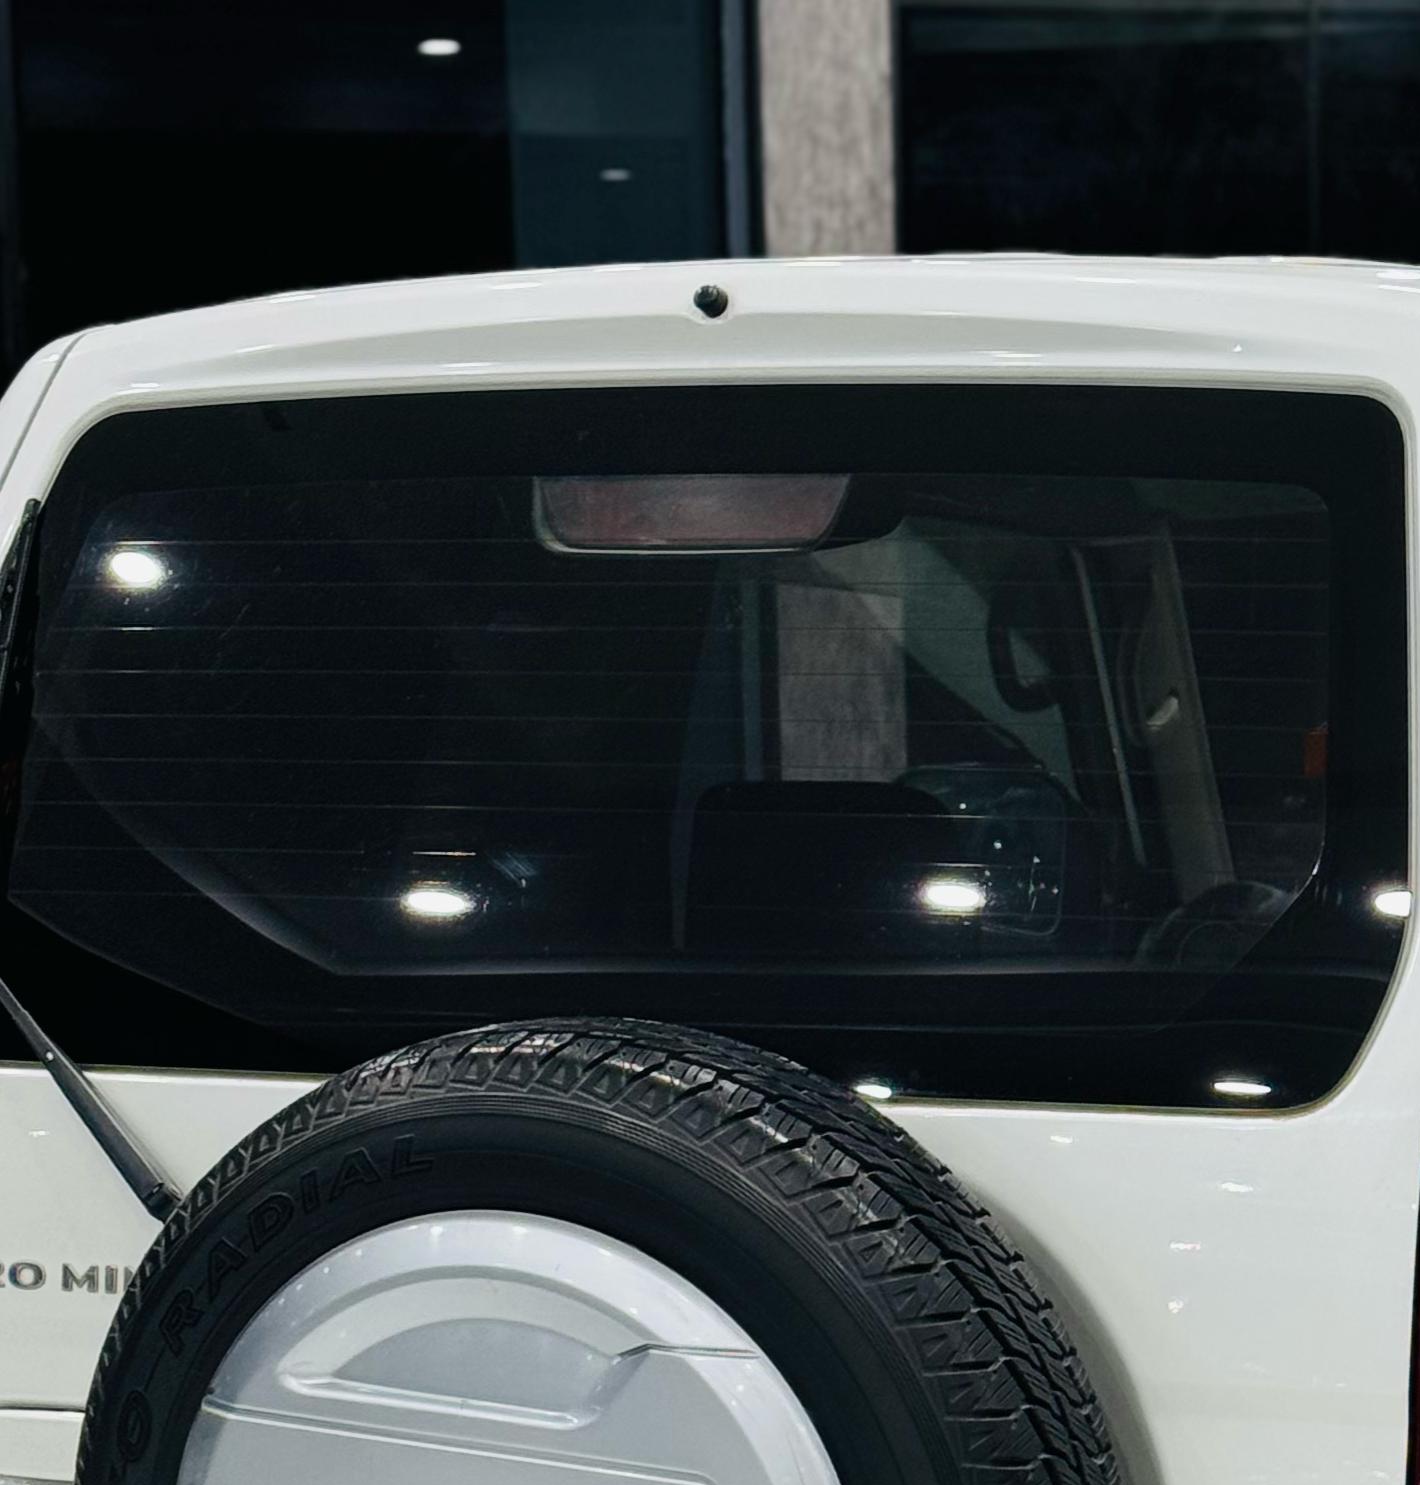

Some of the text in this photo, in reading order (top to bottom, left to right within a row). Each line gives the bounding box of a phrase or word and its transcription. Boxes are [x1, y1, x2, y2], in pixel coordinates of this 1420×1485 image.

[0, 1258, 135, 1294] O MI
[156, 1133, 436, 1357] RADIAL
